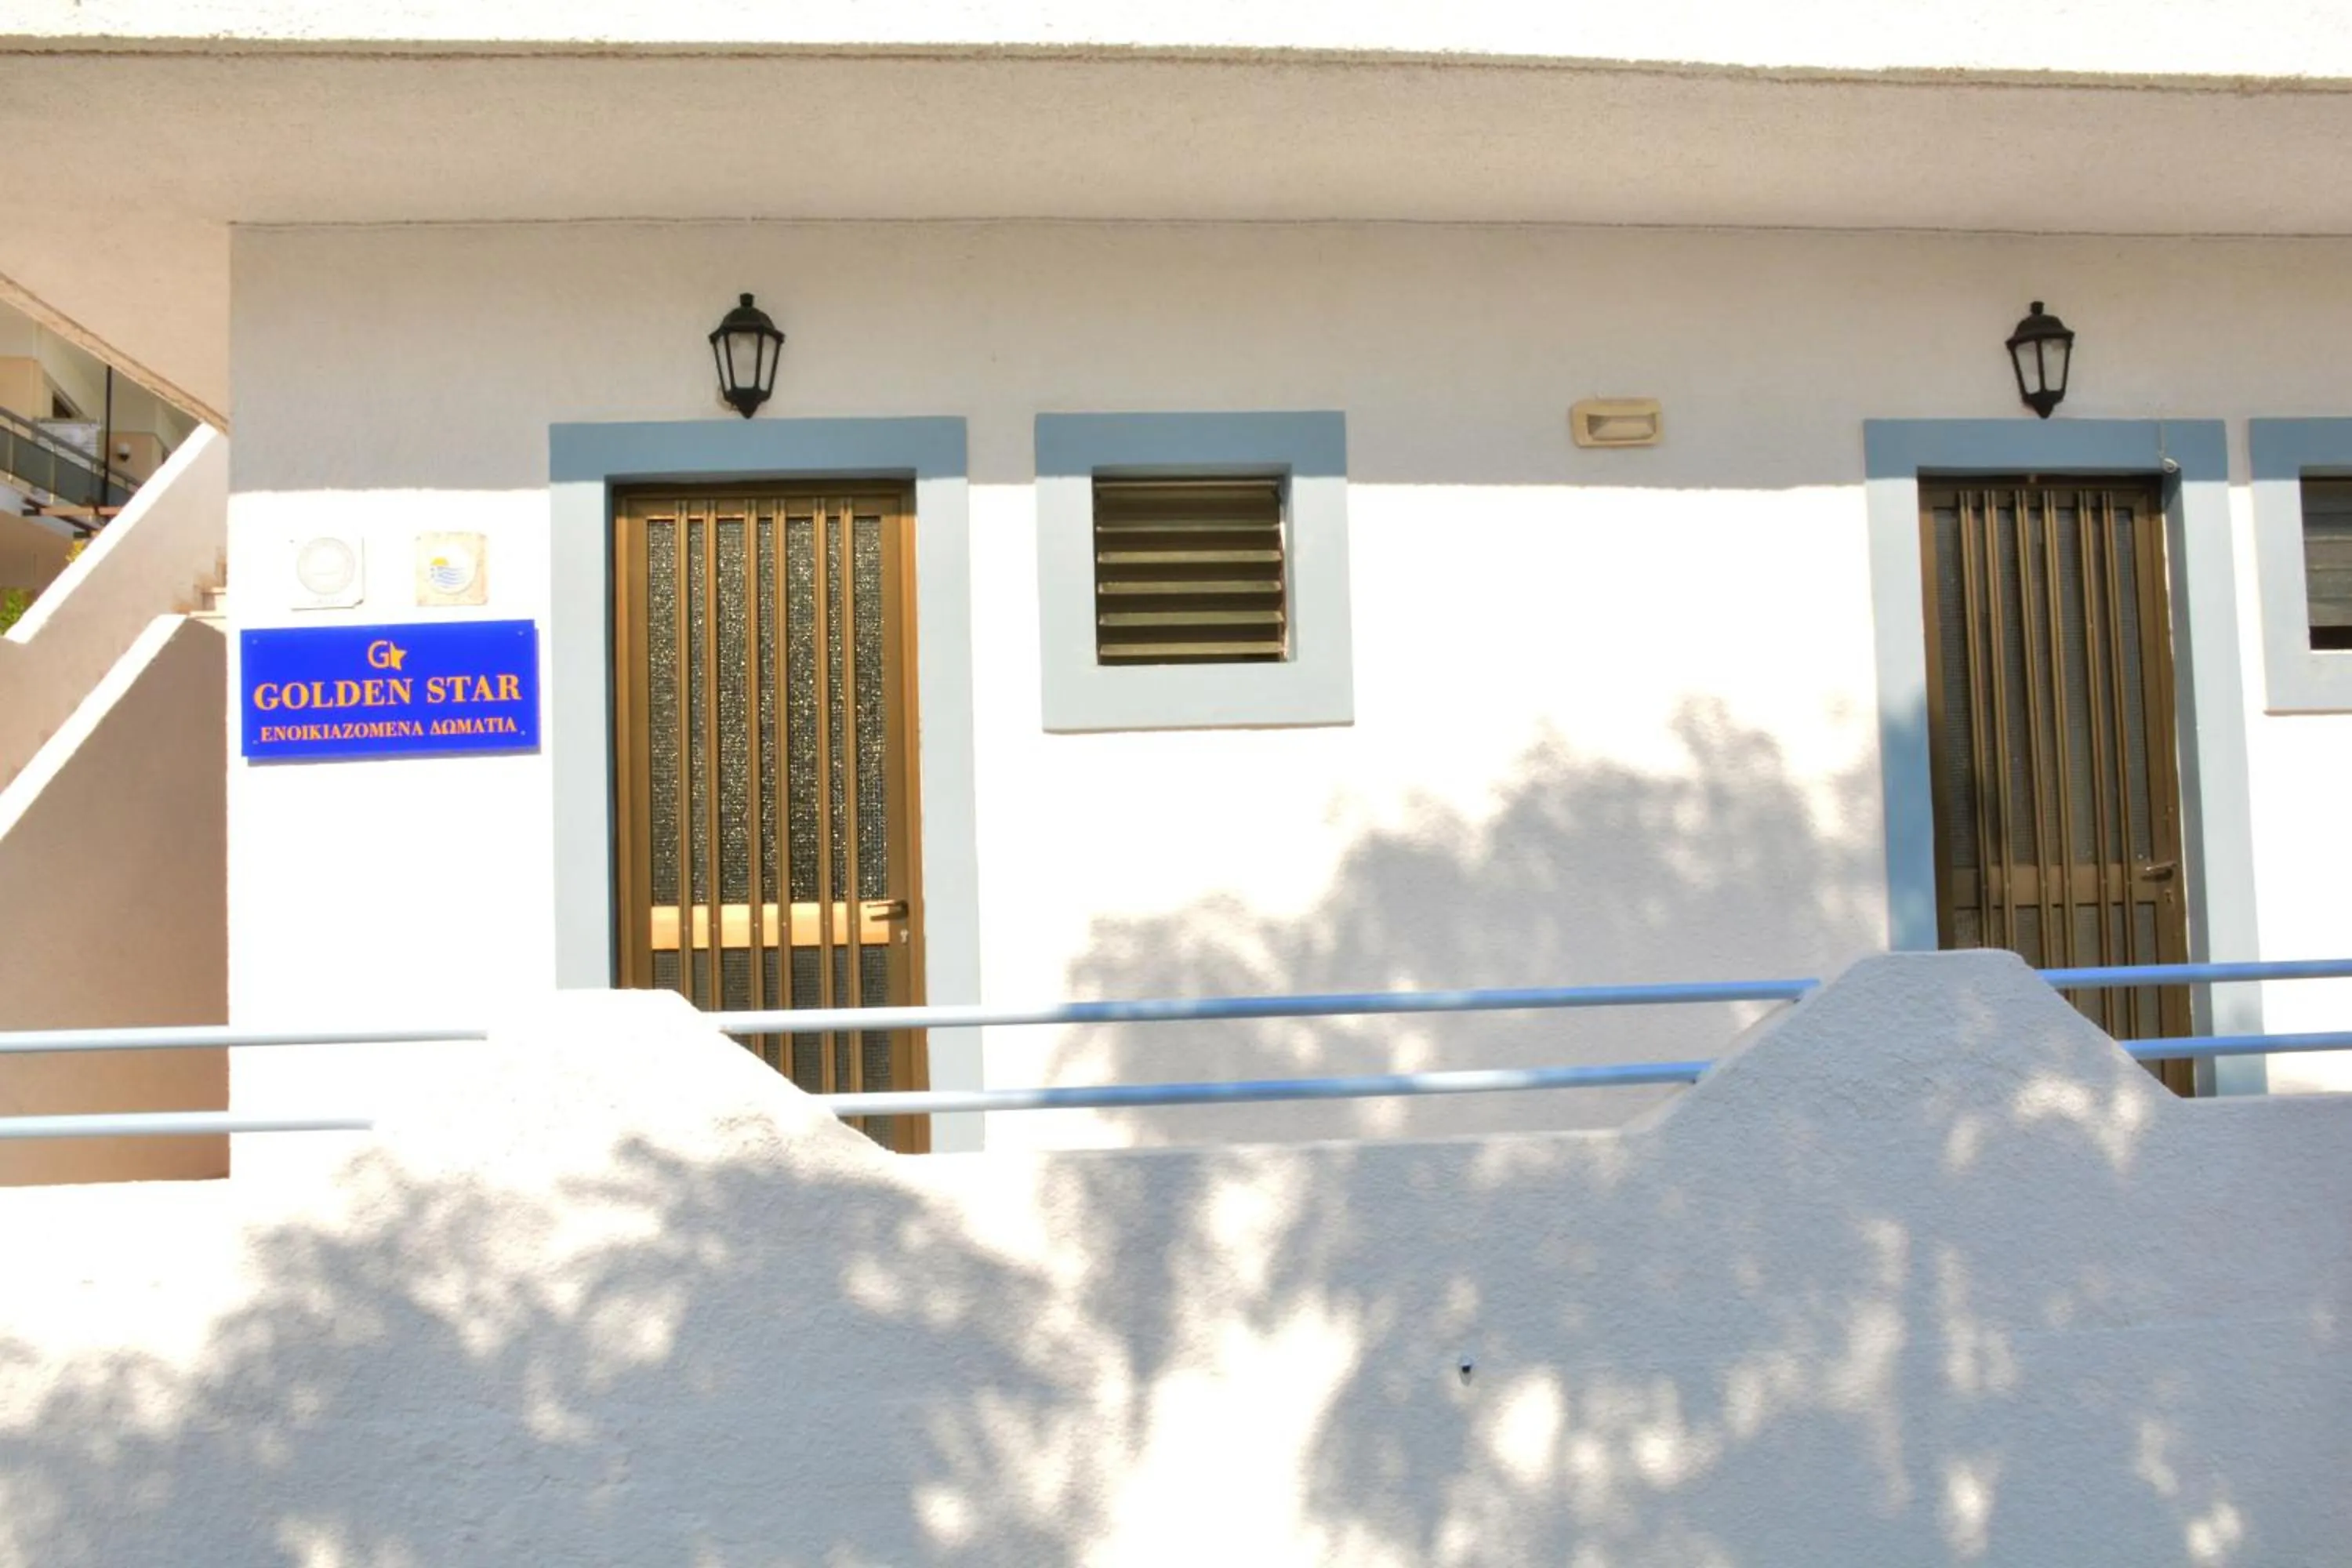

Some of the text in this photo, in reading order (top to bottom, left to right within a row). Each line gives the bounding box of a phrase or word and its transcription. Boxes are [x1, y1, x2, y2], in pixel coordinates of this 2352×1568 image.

[253, 674, 522, 710] GOLDEN STAR
[260, 717, 517, 742] ΕΝΟΙΚΙΑΖΟΜΕΝΑ ΔΩΜΑΤΙΑ
